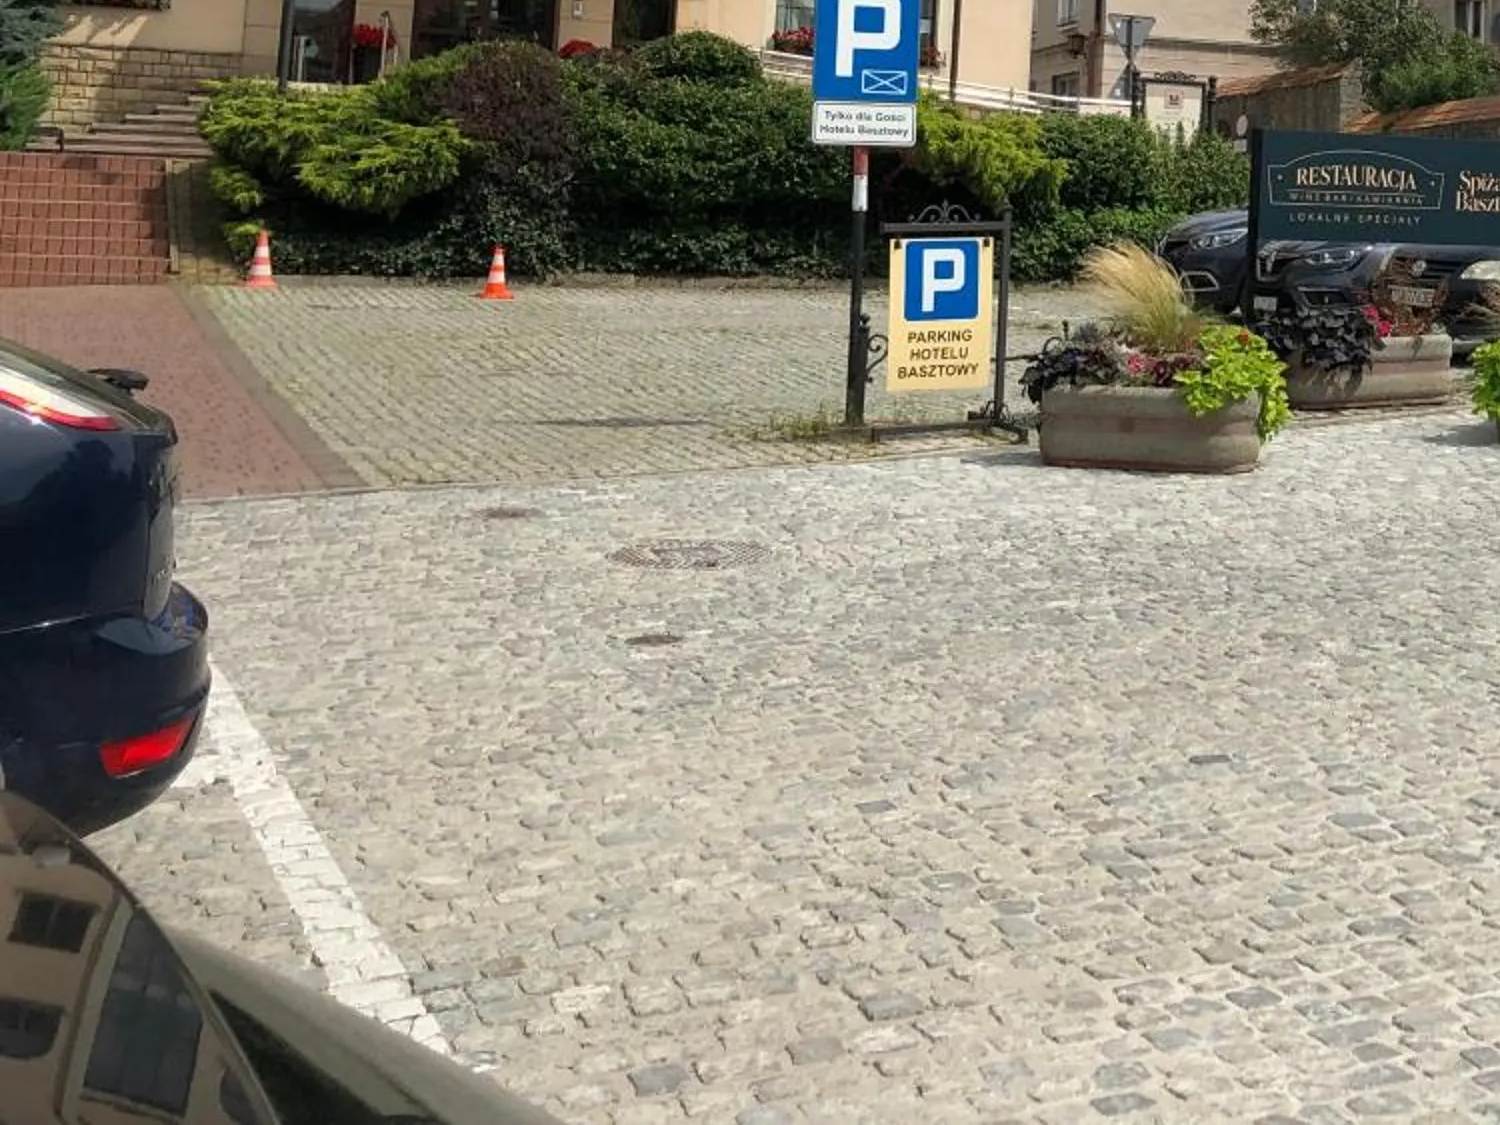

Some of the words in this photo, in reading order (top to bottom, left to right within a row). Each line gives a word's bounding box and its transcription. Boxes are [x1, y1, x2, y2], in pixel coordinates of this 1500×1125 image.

[825, 110, 853, 122] Tylko
[1296, 164, 1418, 192] RESTAURACJA
[921, 247, 966, 313] P
[907, 329, 973, 344] PARKING
[909, 346, 969, 361] HOTELU
[896, 362, 979, 380] BASZTOWY
